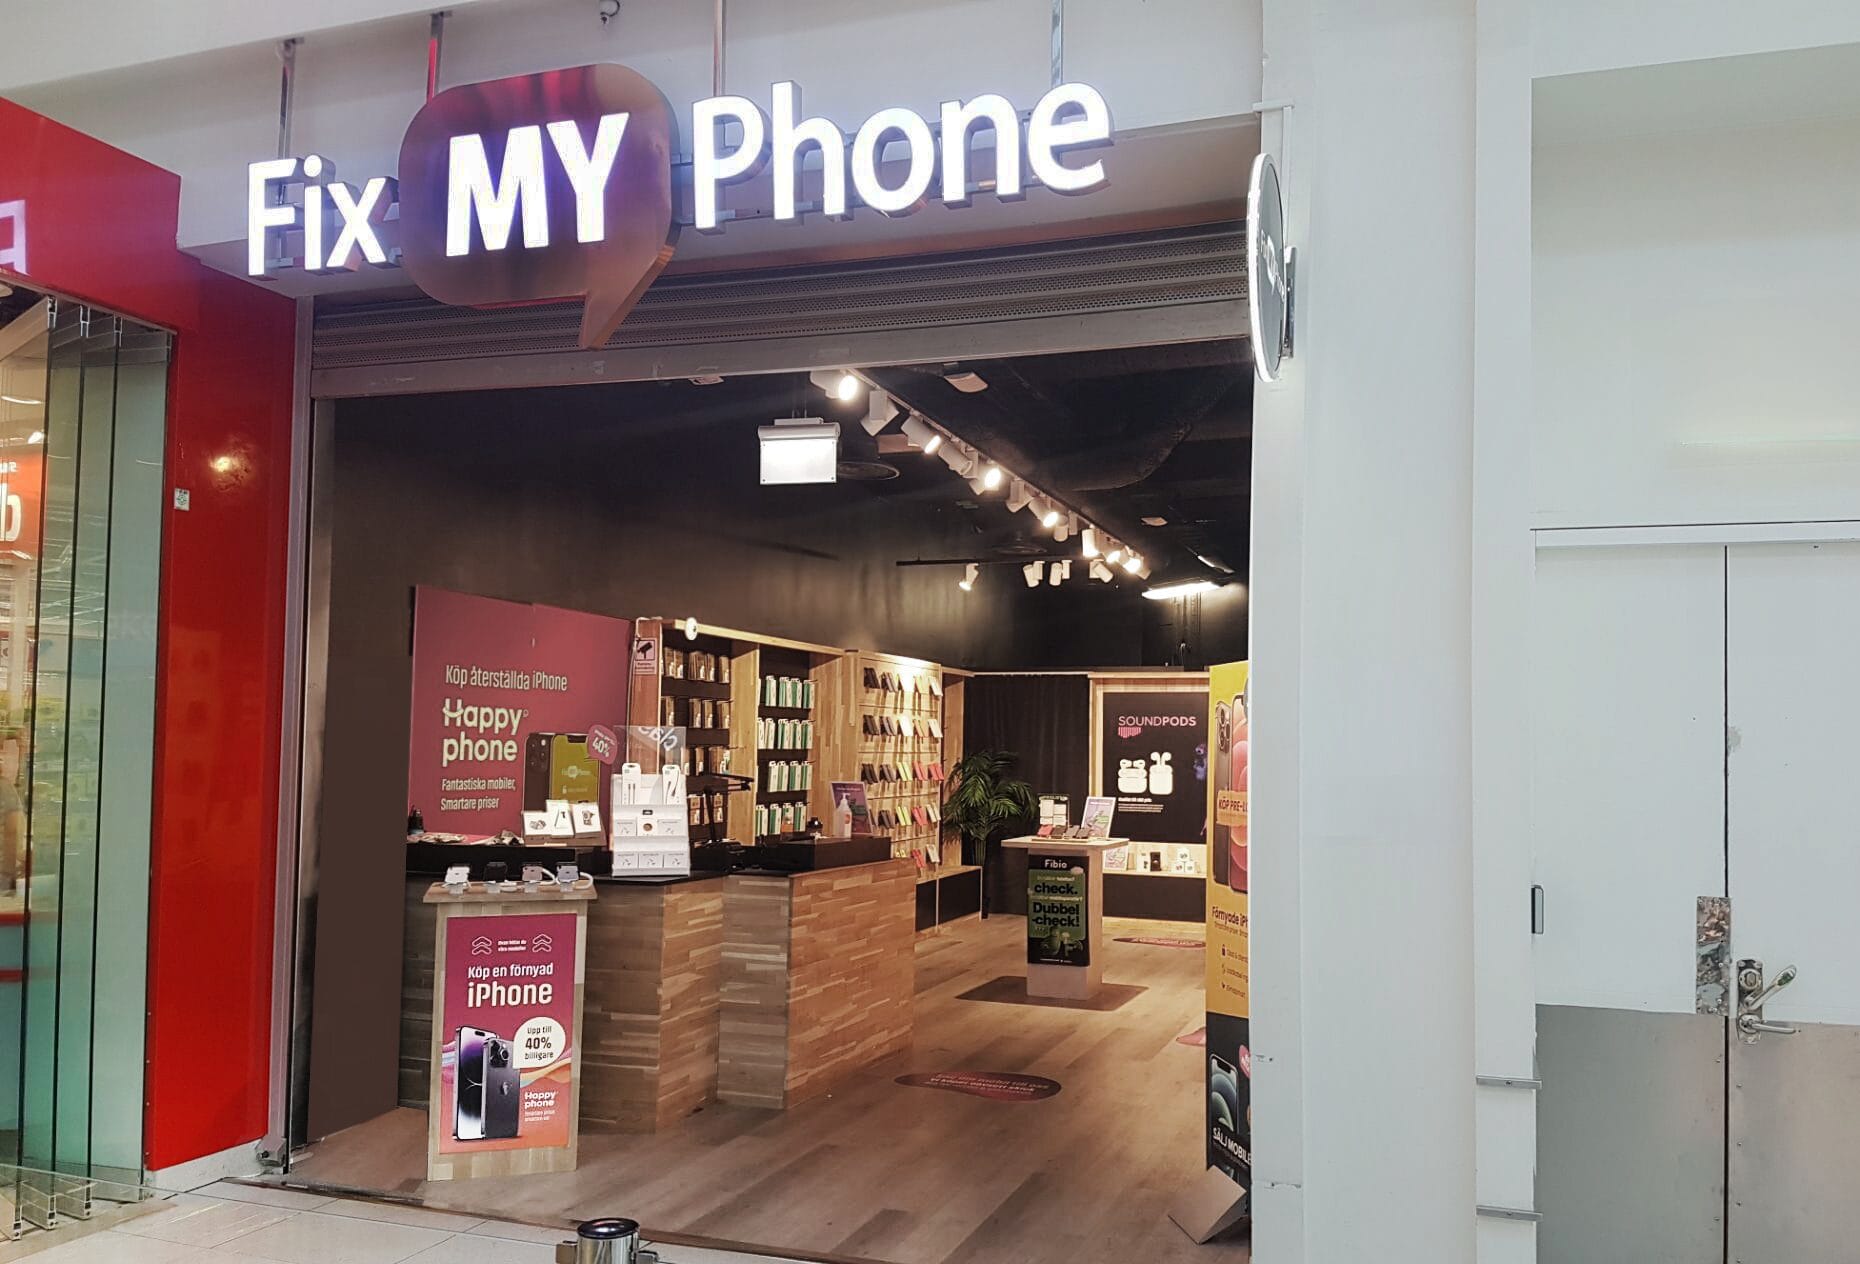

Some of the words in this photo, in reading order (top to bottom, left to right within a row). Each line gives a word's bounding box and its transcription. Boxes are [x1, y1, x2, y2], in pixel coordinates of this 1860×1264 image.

[248, 155, 387, 276] Fix
[446, 112, 629, 258] MY
[692, 80, 1110, 230] Phone
[445, 665, 467, 688] Köp
[470, 666, 530, 690] återställda
[532, 670, 568, 691] iPhone
[442, 698, 522, 735] Happy
[1118, 716, 1197, 726] SOUNDPODS
[442, 731, 518, 767] phone
[441, 777, 486, 791] Fantastiska
[440, 797, 476, 811] Smartare
[477, 796, 499, 811] priser
[1044, 859, 1067, 869] Fibio
[1034, 883, 1078, 895] check.
[1033, 902, 1080, 915] Dubbel
[1032, 915, 1080, 927] -check!
[467, 965, 489, 980] Köp
[492, 967, 507, 977] en
[510, 962, 554, 978] förnyad
[467, 981, 553, 1008] iPhone
[525, 1036, 552, 1049] 40%
[525, 1051, 554, 1060] billigare
[524, 1100, 554, 1110] phone
